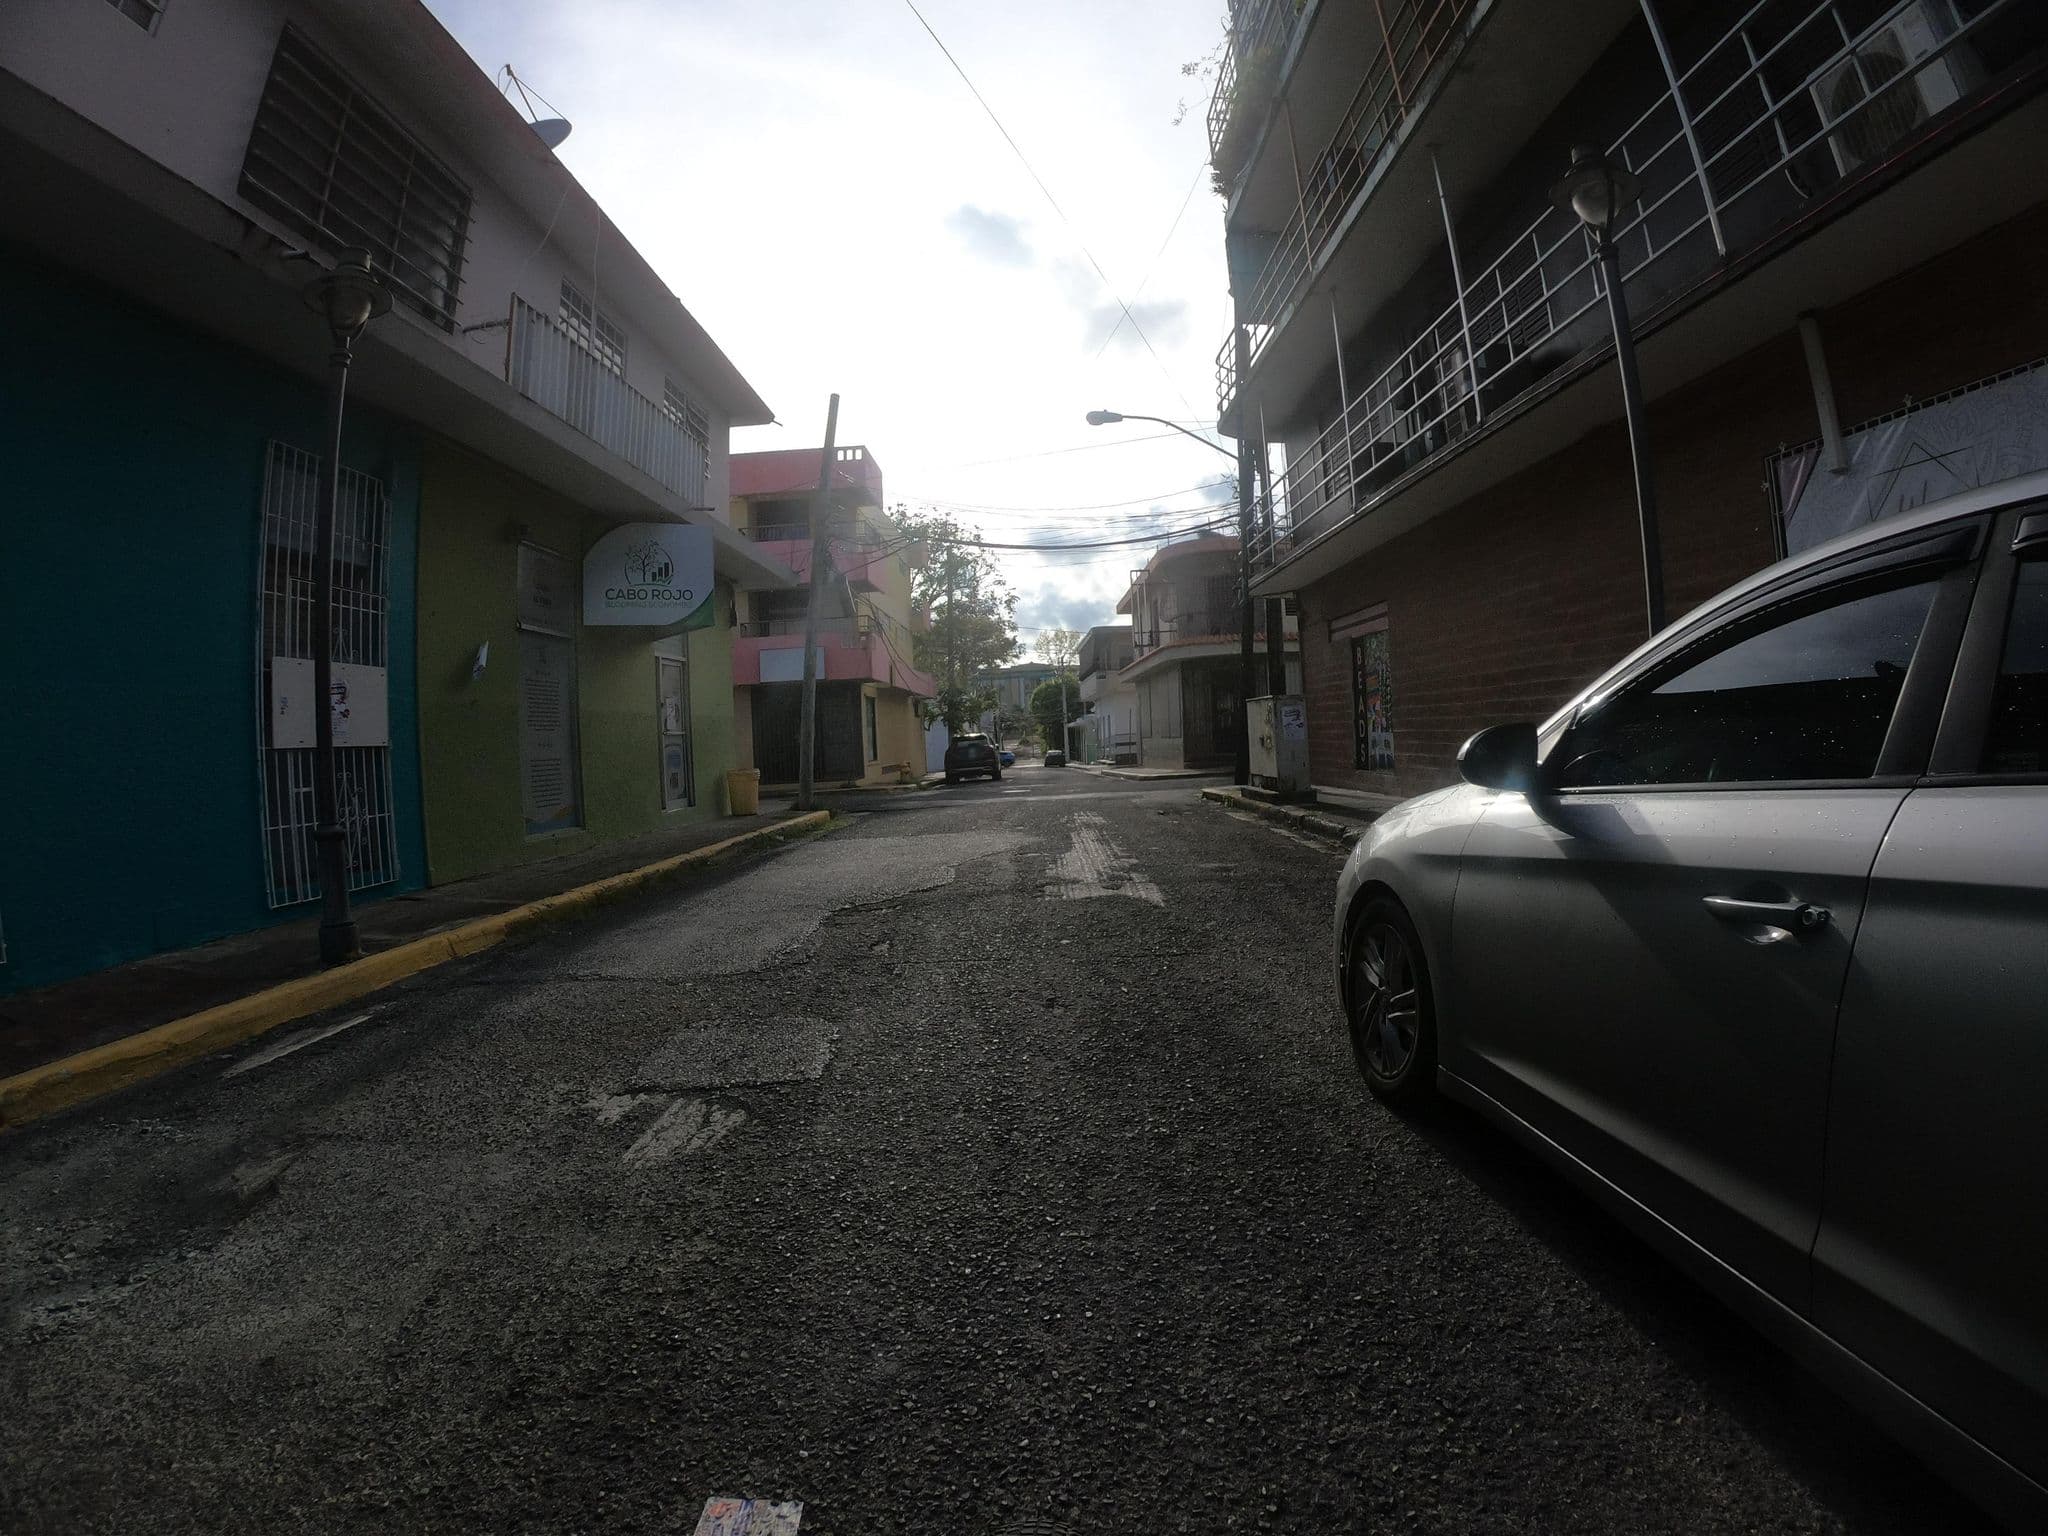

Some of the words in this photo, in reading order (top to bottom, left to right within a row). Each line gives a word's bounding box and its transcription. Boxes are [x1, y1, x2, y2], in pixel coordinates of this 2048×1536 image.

[605, 588, 648, 600] CABO
[651, 589, 694, 601] ROJO
[1356, 647, 1367, 762] BEADS
